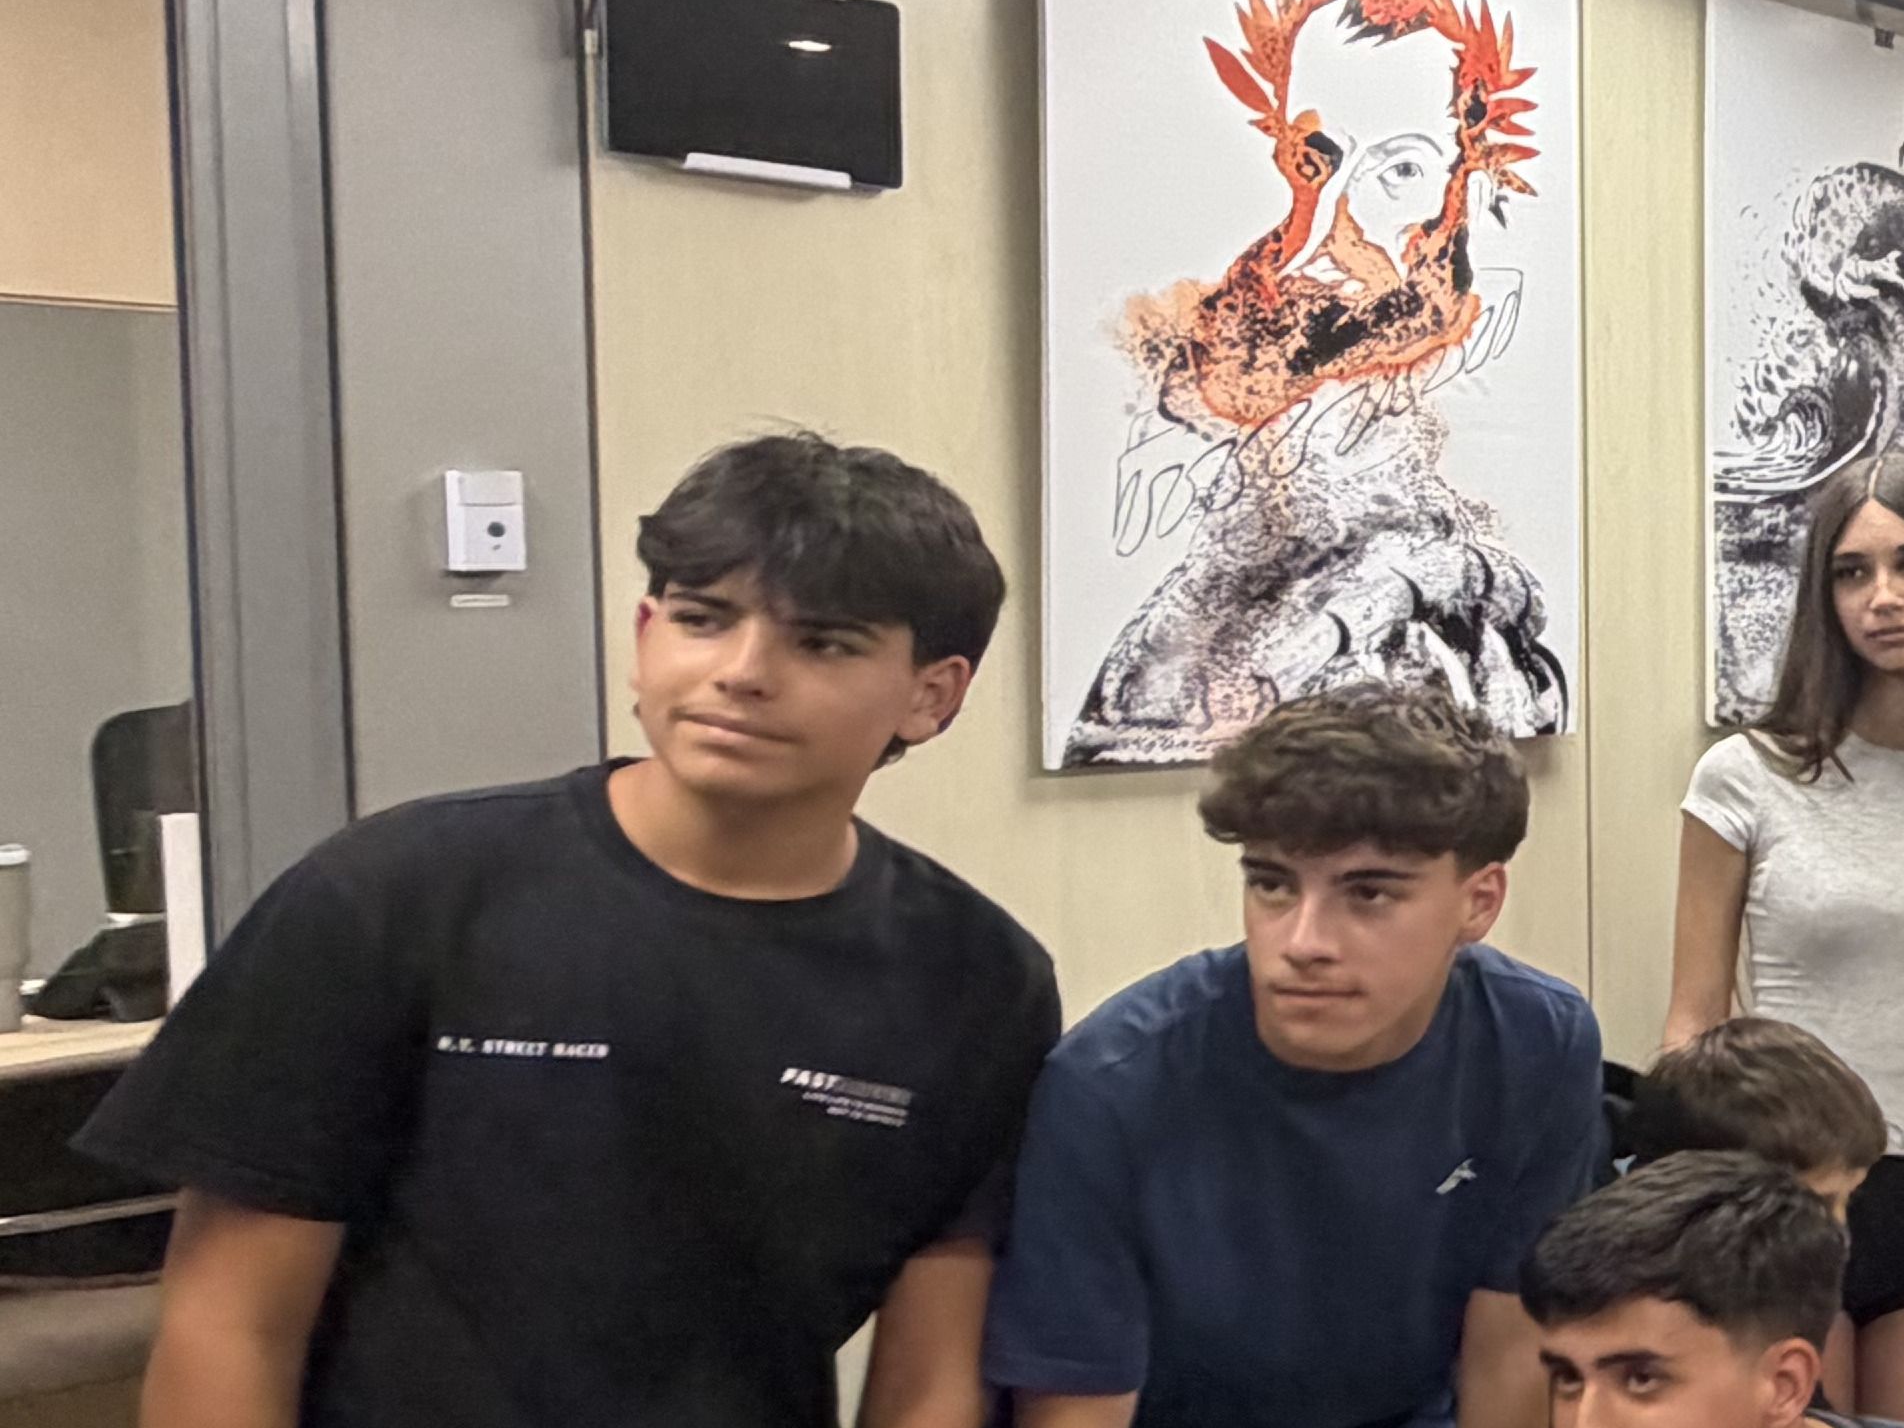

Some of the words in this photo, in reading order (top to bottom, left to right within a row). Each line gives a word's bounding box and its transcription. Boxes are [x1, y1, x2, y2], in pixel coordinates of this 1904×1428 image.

[481, 1038, 550, 1057] STREET
[552, 1042, 610, 1059] RACER
[780, 1067, 841, 1091] FAST
